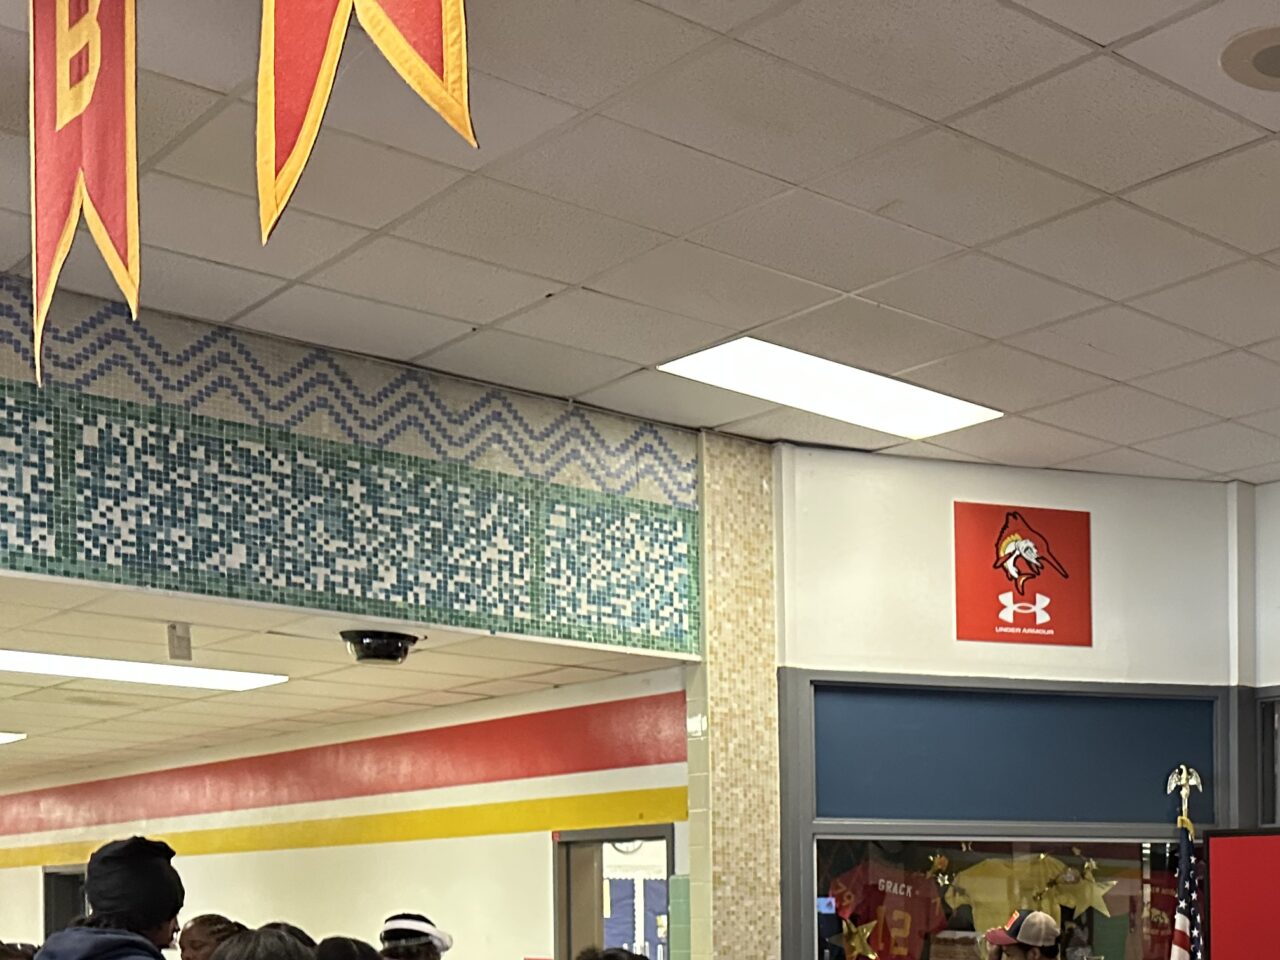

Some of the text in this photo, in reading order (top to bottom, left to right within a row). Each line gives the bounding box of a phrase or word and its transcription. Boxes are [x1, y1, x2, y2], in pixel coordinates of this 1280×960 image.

[995, 626, 1054, 635] UNDER ARMOUR
[878, 878, 913, 898] GRACK
